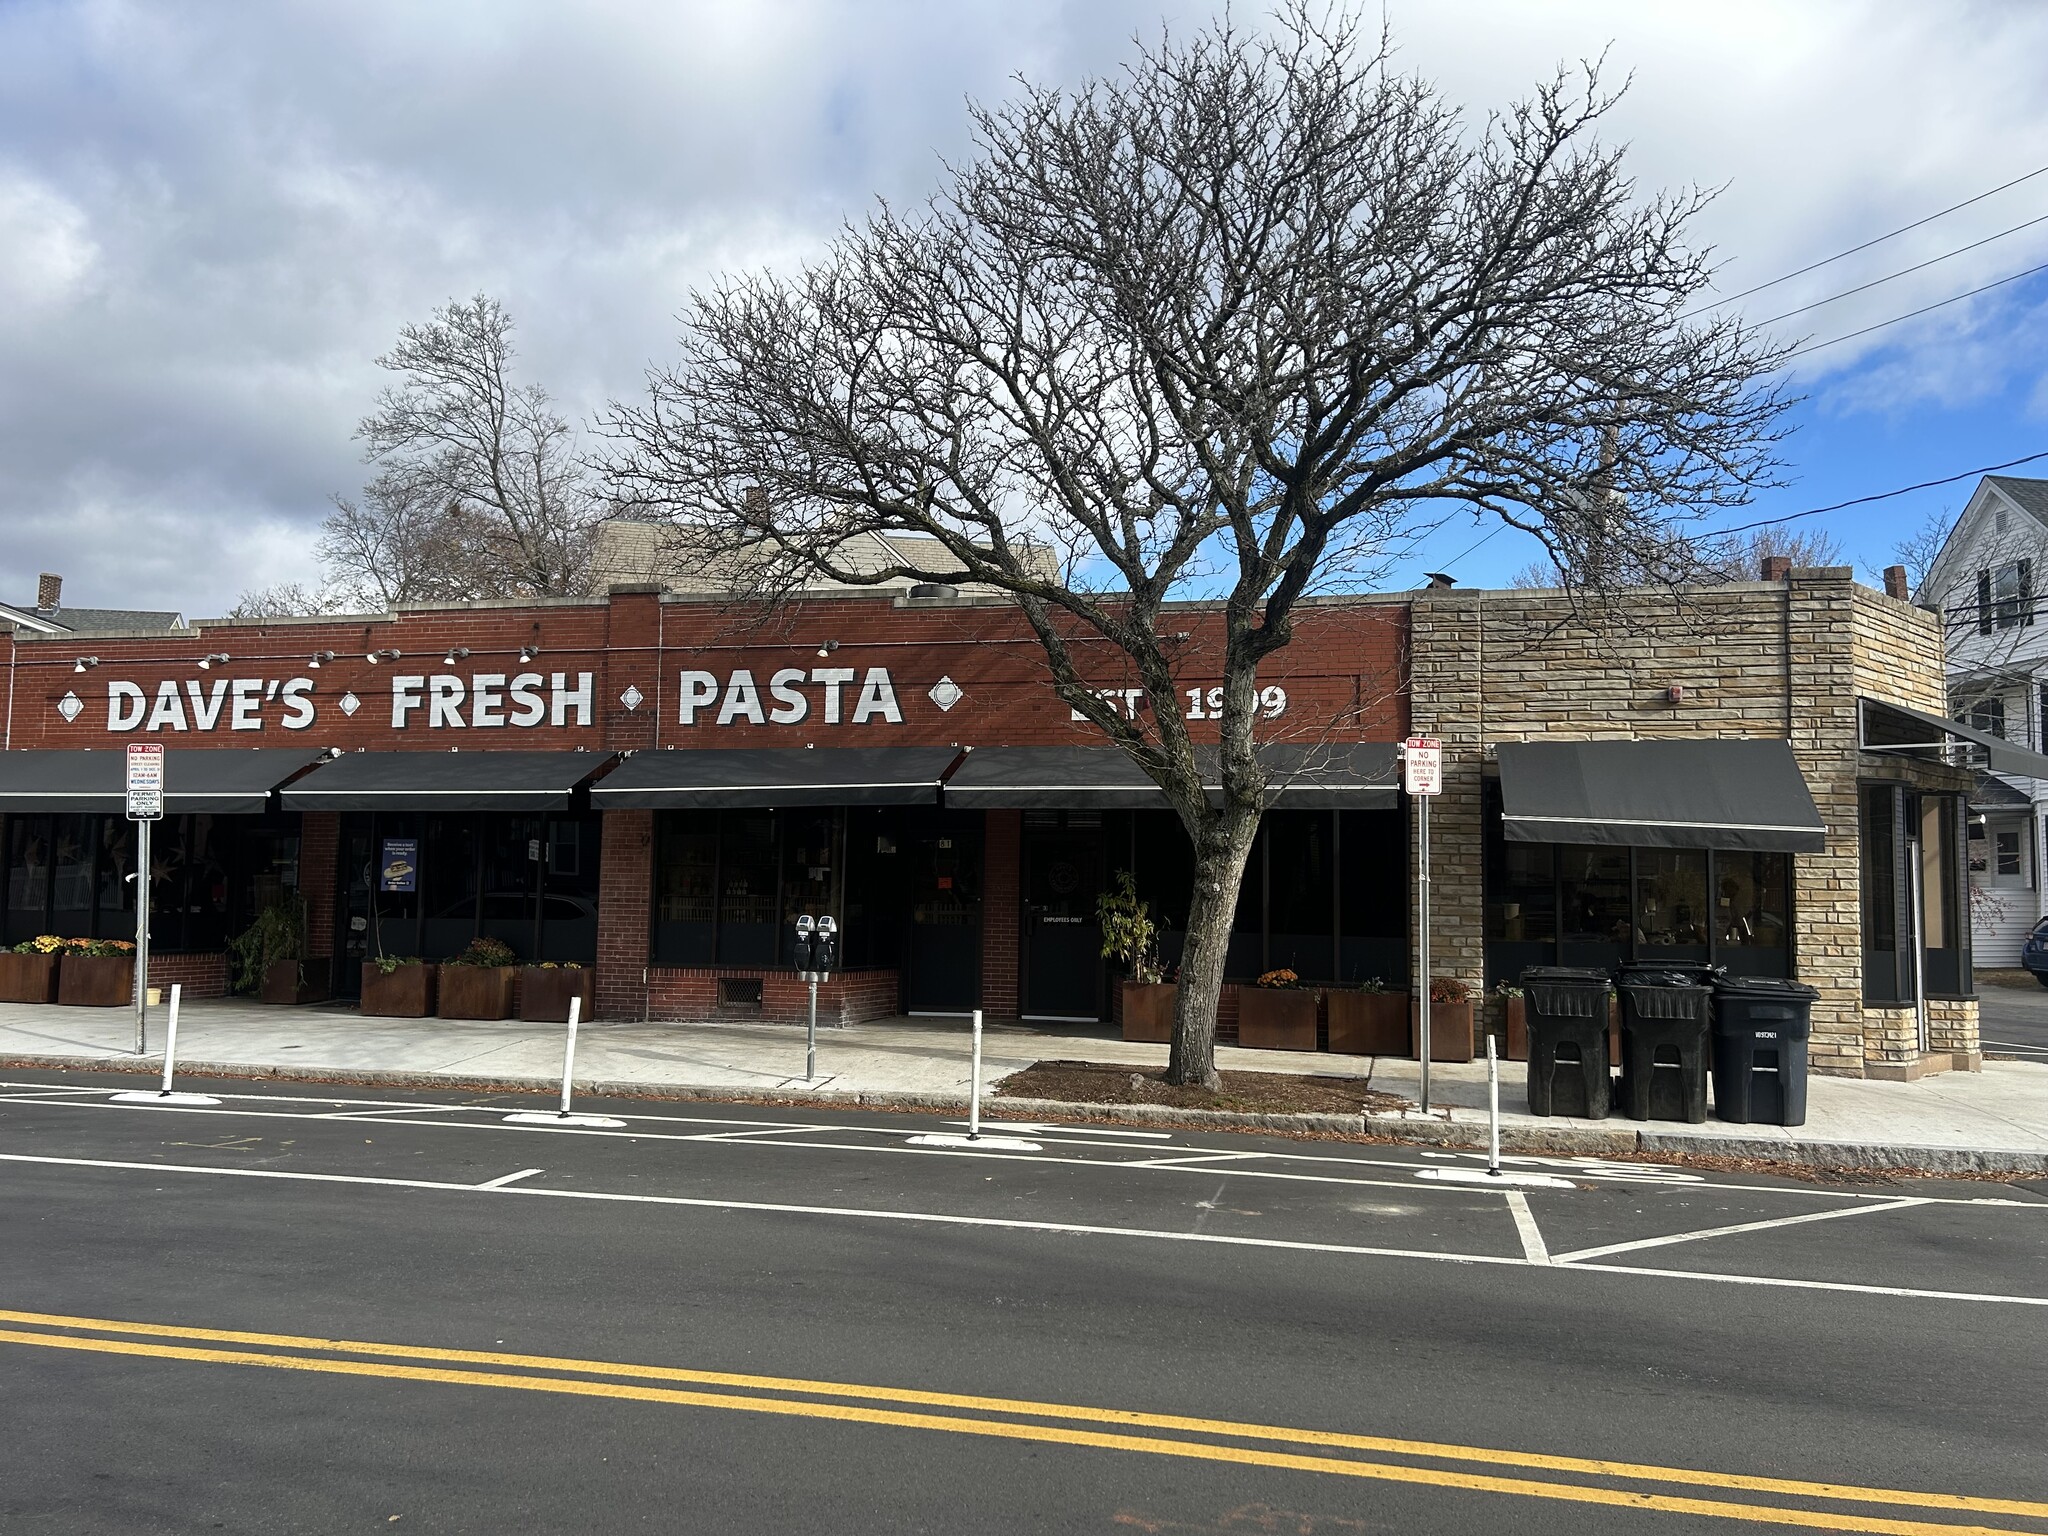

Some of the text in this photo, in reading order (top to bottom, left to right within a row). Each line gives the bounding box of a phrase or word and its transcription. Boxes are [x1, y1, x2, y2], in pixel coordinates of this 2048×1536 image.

[107, 667, 904, 732] DAVE'S FRESH PASTA
[1185, 685, 1287, 720] 199
[1408, 740, 1440, 748] TOW ZONE
[1418, 751, 1429, 759] NO
[1410, 760, 1437, 768] PARKING
